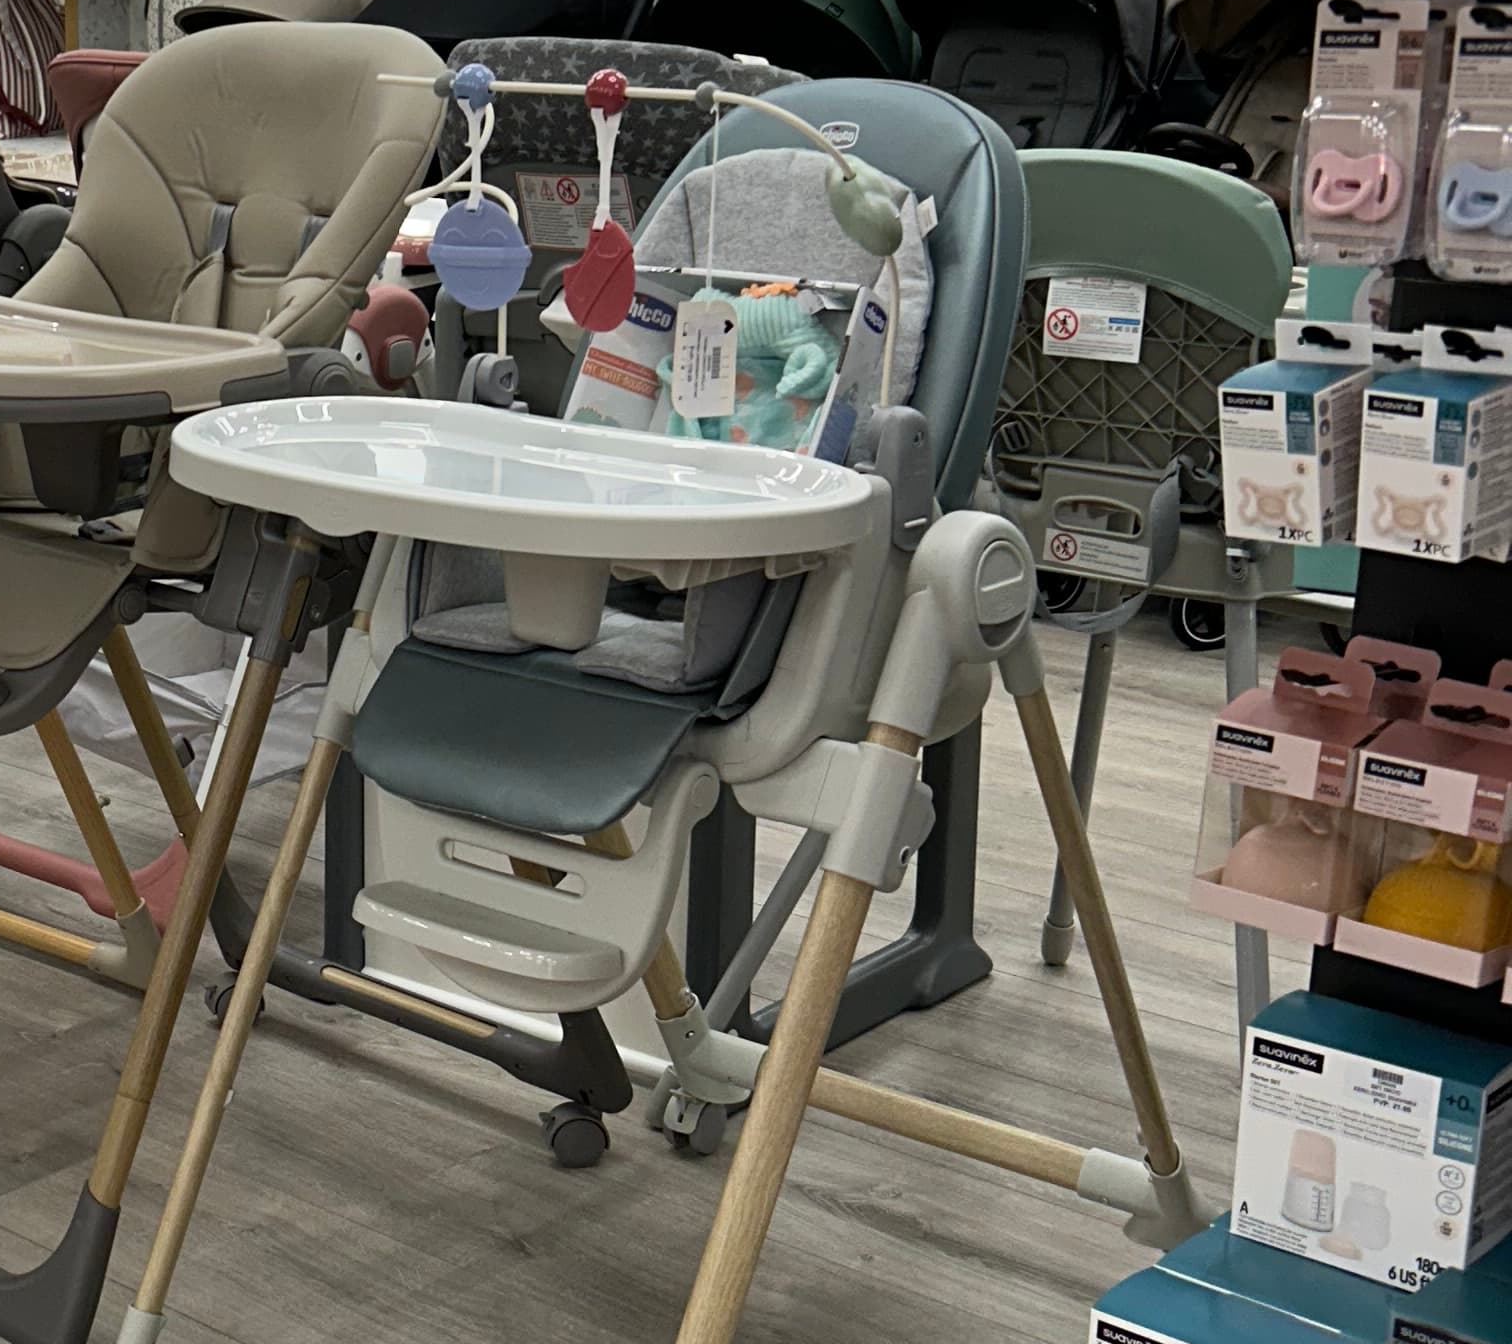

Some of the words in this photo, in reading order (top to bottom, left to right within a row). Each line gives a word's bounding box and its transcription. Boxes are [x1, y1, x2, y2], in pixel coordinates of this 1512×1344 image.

[628, 296, 672, 329] hicco
[1239, 1200, 1249, 1215] A
[1387, 1265, 1397, 1281] 6
[1399, 1267, 1418, 1287] US
